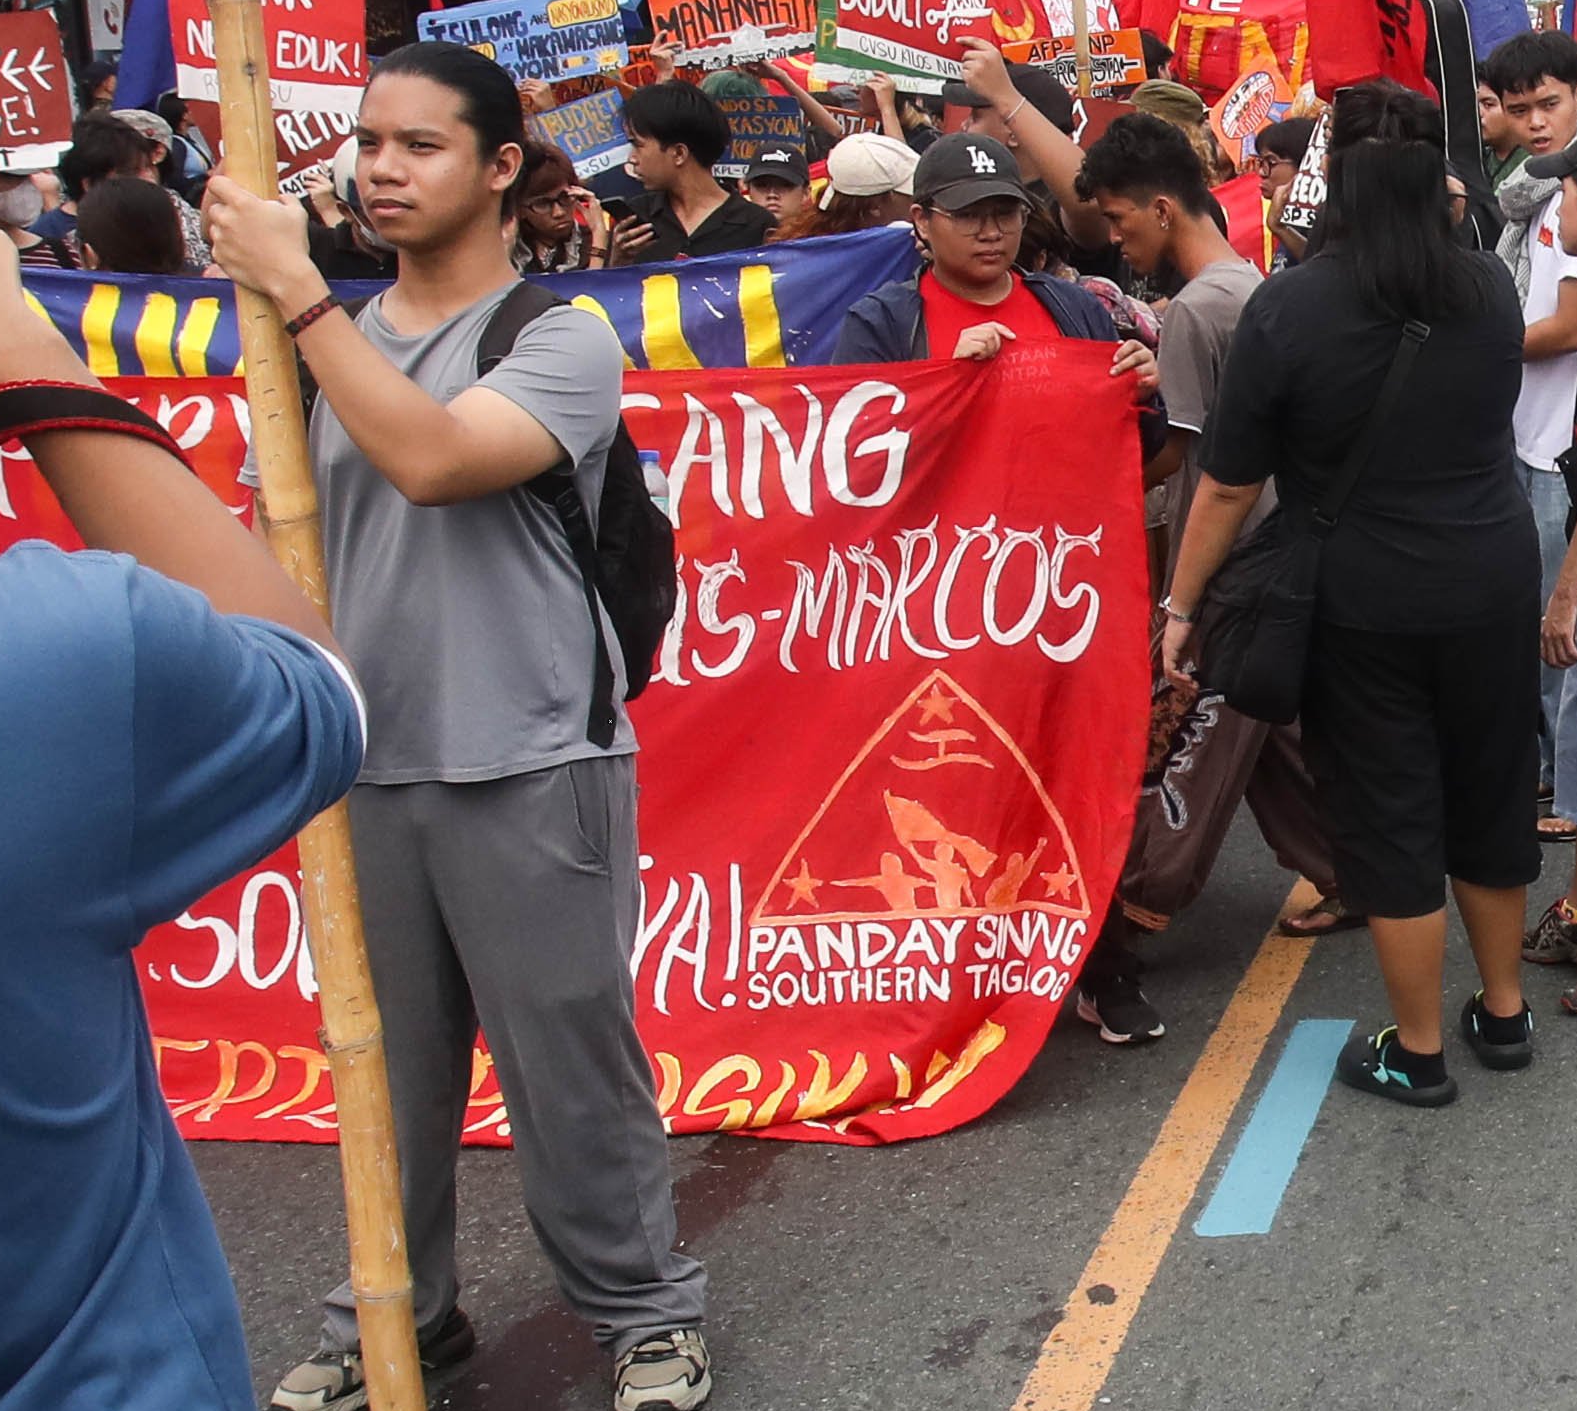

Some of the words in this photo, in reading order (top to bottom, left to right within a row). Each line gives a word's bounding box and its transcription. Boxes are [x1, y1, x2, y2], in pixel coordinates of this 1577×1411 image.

[276, 30, 361, 78] EDUK!
[1028, 33, 1115, 62] AFP-NP
[747, 917, 967, 974] PANDAY
[747, 970, 952, 1011] SOUTHERN
